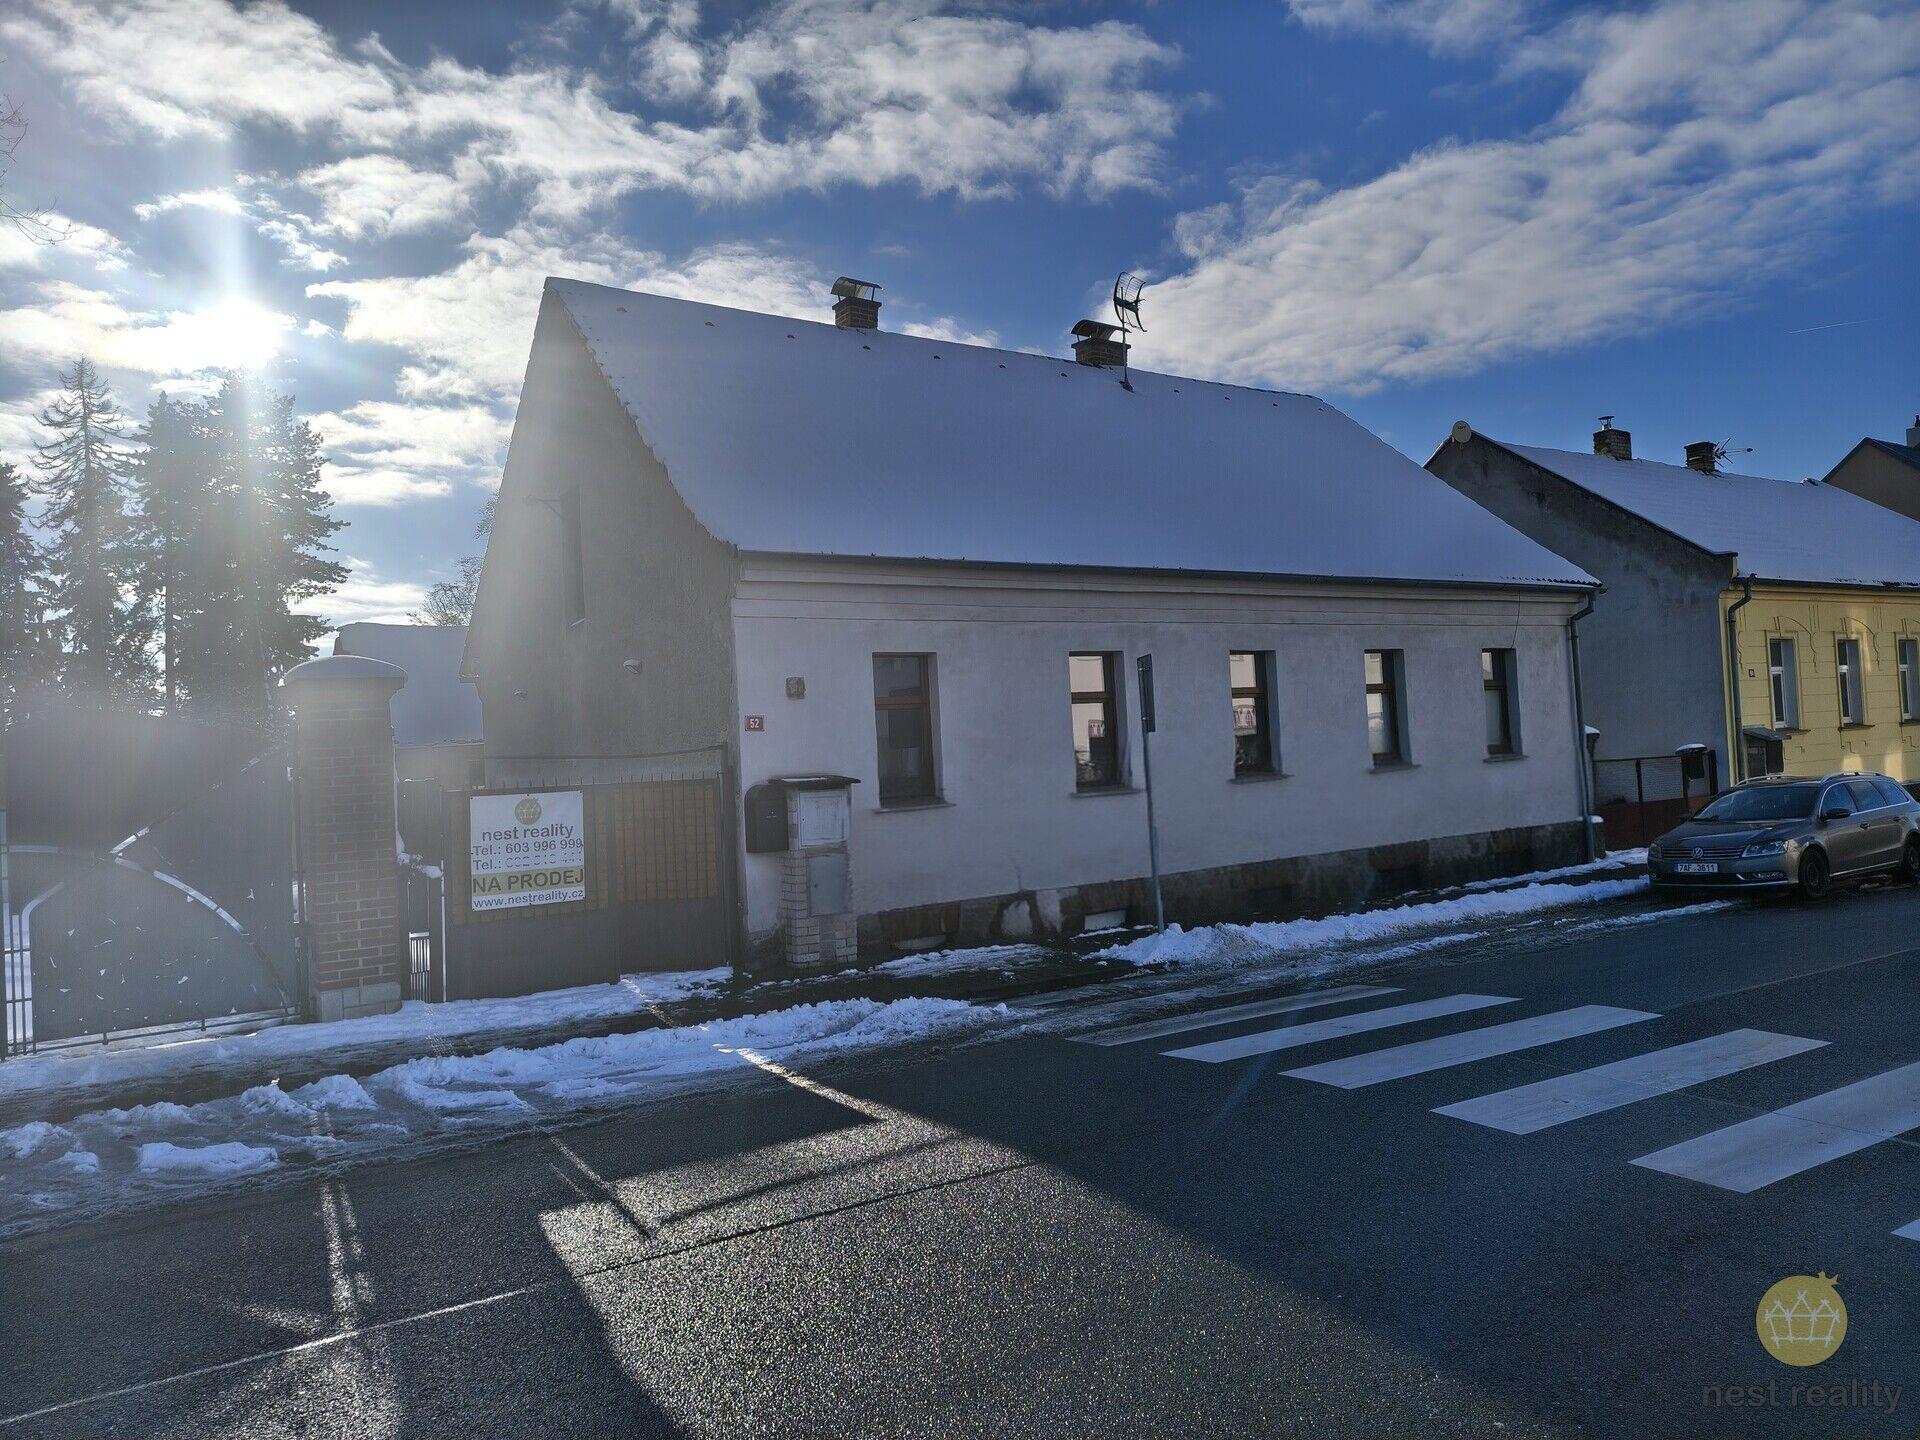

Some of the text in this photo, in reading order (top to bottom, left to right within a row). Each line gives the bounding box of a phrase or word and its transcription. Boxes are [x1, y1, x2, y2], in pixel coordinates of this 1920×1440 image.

[749, 718, 760, 729] 52
[482, 823, 574, 841] nest reality
[473, 838, 583, 856] Tel.: 603 996 999
[473, 859, 501, 870] Tel.:
[473, 869, 584, 893] NA PRODEJ
[473, 889, 583, 908] www.nestreality.cz
